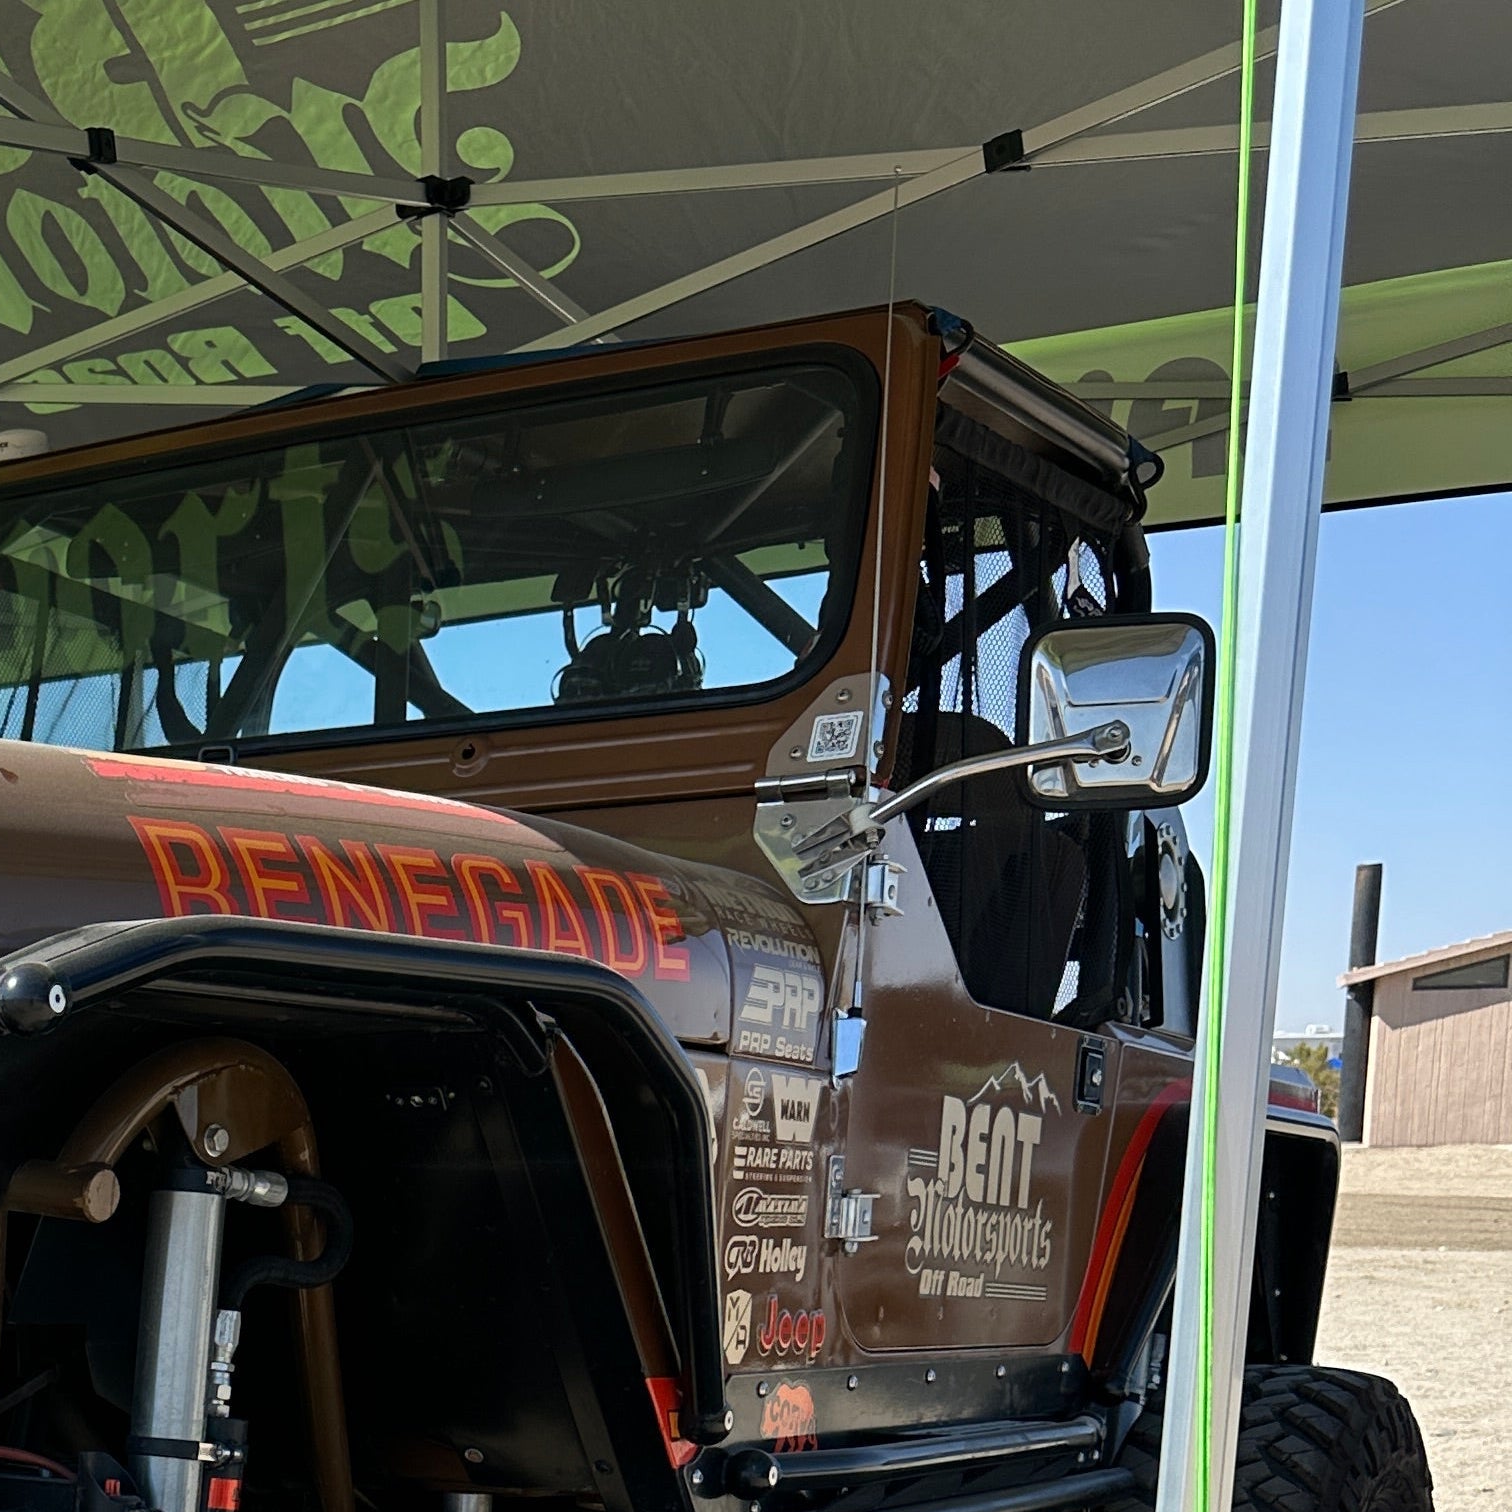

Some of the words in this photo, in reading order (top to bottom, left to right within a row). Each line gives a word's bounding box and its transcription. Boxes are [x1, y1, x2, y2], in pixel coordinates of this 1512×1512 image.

[127, 815, 691, 982] RENEGADE
[725, 927, 821, 965] REVOLUTION
[740, 1030, 772, 1055] PRP
[775, 1036, 814, 1060] Seats
[780, 1098, 811, 1123] WARN
[746, 1146, 778, 1169] RARE
[778, 1149, 814, 1171] PARTS
[938, 1095, 1043, 1209] BENT
[905, 1173, 1053, 1280] Motorsports
[758, 1238, 808, 1283] Holley
[919, 1268, 945, 1295] Off
[946, 1270, 985, 1298] Road
[757, 1292, 826, 1364] Jeep
